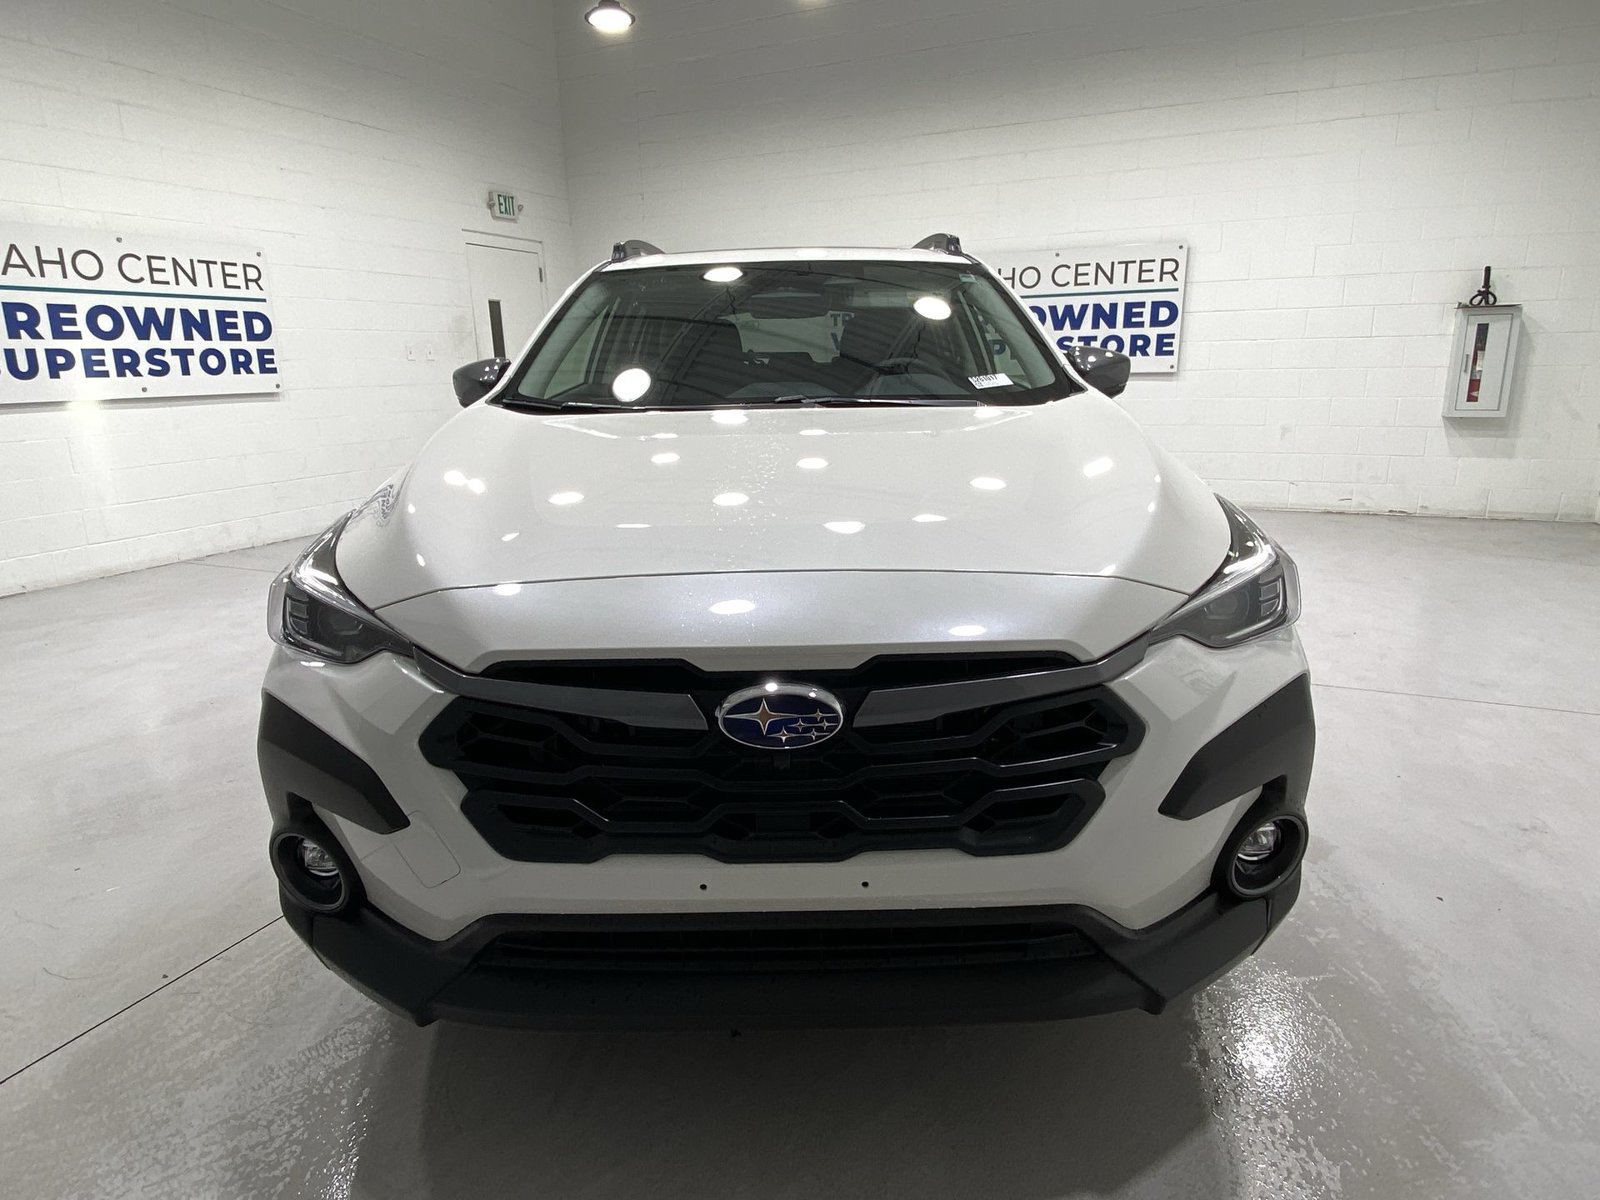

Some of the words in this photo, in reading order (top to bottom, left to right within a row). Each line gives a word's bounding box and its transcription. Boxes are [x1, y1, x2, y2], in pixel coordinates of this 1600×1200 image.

[497, 194, 515, 216] EXIT
[1, 244, 104, 281] AHO
[117, 253, 264, 291] CENTER
[1052, 258, 1180, 287] CENTER
[2, 302, 273, 341] REOWNED
[0, 348, 278, 380] UPERSTORE
